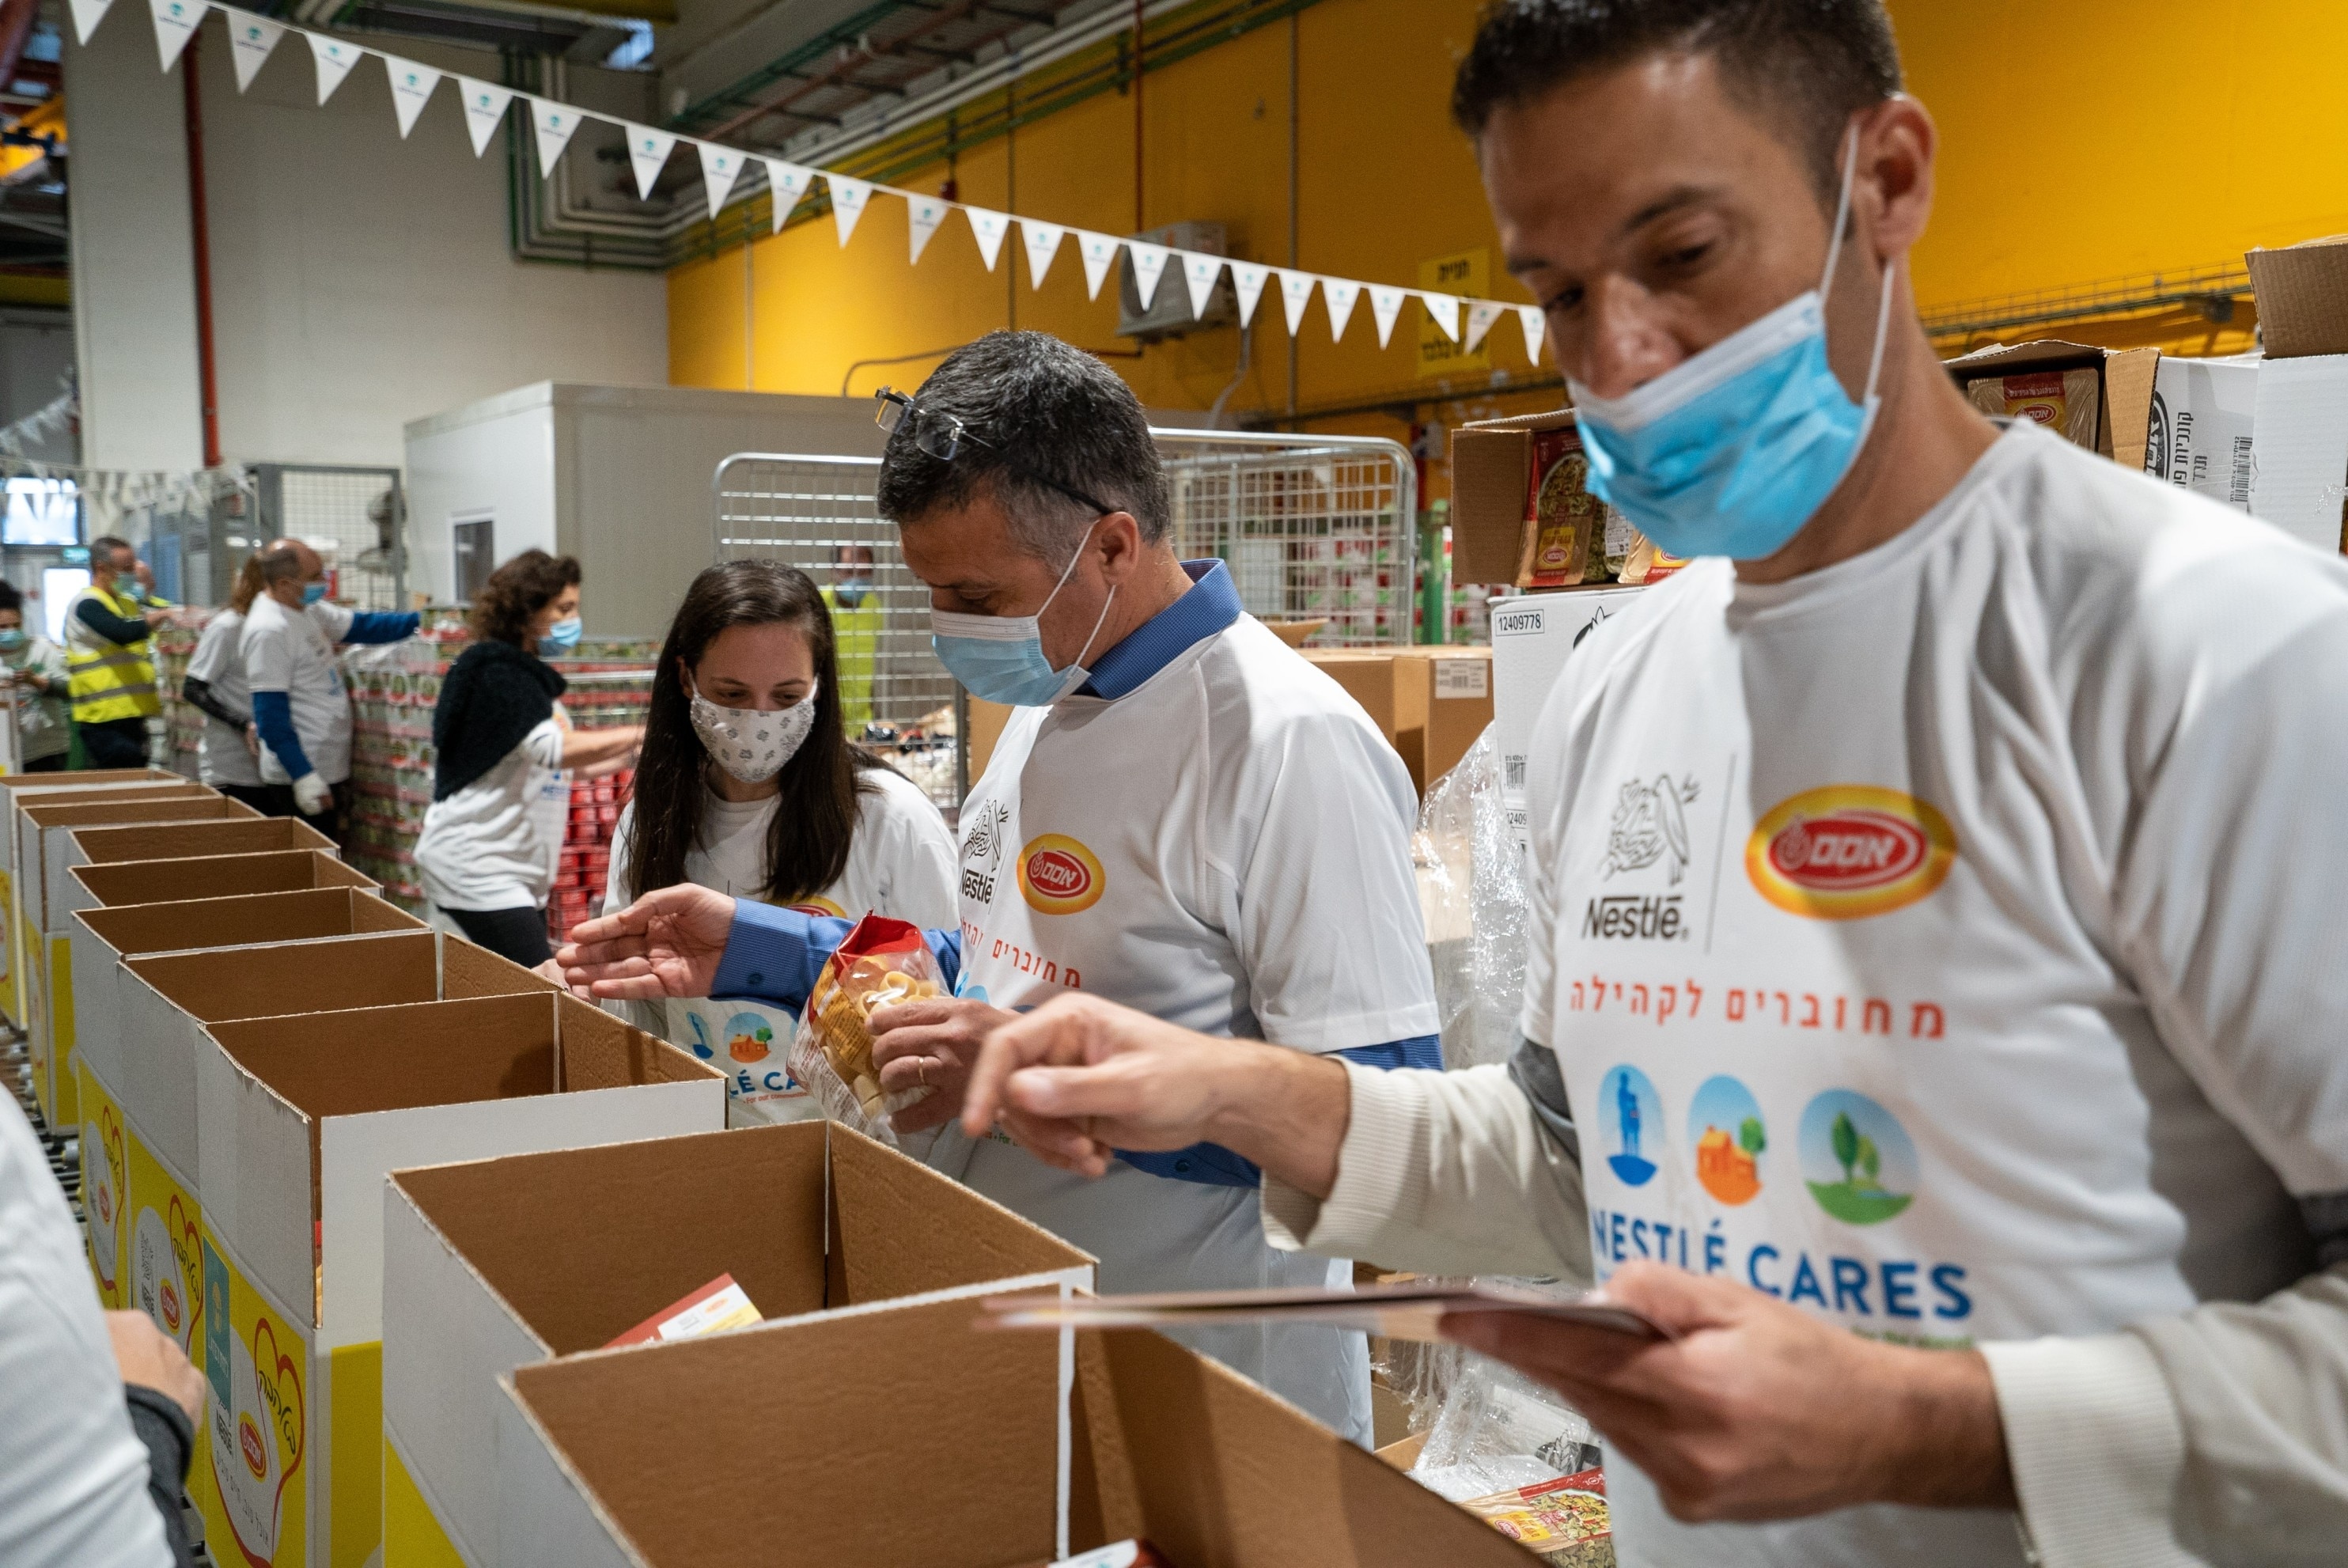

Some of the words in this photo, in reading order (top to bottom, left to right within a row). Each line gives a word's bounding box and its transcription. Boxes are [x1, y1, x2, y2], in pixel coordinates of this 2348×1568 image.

[2175, 412, 2194, 465] קונכיות
[1498, 614, 1542, 631] 12409778
[1041, 862, 1077, 888] אסם
[1815, 835, 1897, 870] אסם
[959, 867, 994, 905] Nestlé
[1582, 895, 1683, 941] Nestlé
[992, 938, 1081, 989] מחוברים
[1570, 974, 1705, 1028] לקהילה
[1726, 987, 1947, 1040] מחוברים
[1748, 1243, 1975, 1322] CARES
